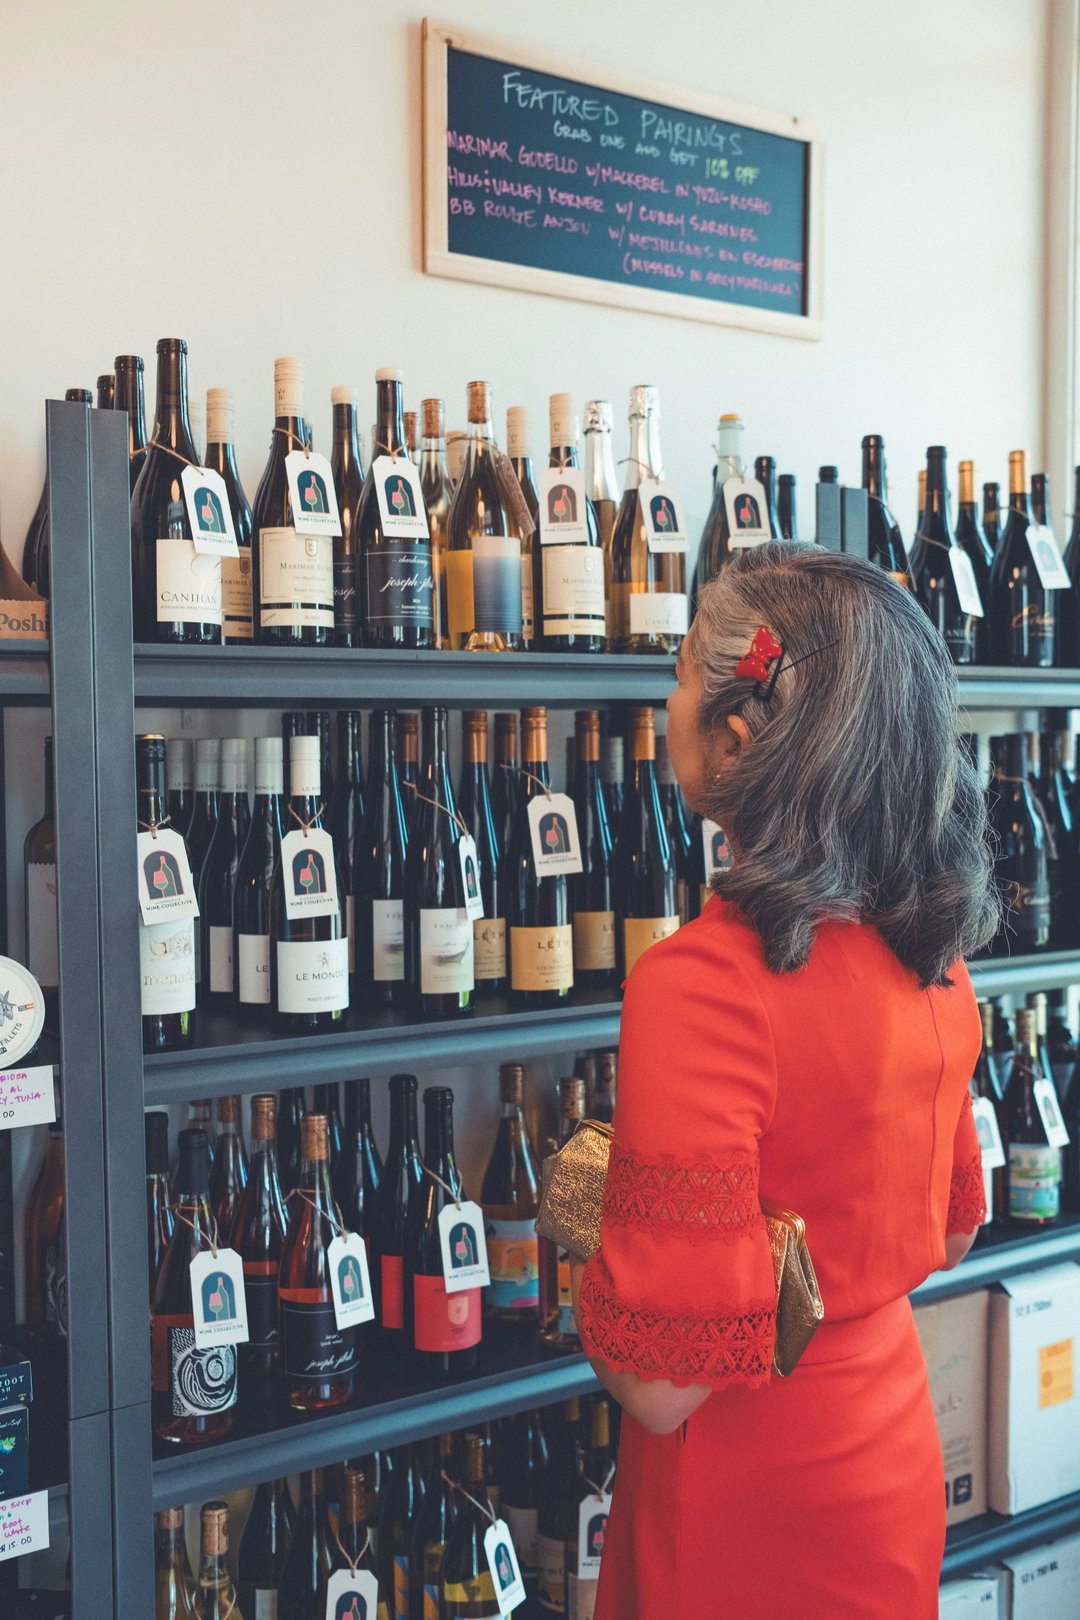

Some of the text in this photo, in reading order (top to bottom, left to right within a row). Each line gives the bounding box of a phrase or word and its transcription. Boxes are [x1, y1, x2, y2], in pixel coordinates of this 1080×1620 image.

[502, 71, 743, 155] FEATURED PAIRINGS
[518, 144, 579, 174] GODELLO
[553, 120, 592, 142] GRAB
[635, 143, 661, 158] AND
[735, 166, 760, 185] OFF
[449, 197, 476, 216] BB
[548, 186, 605, 213] KERNER
[639, 204, 685, 236] CURRY
[688, 214, 758, 243] SARDINES
[295, 969, 344, 981] LE MONDE
